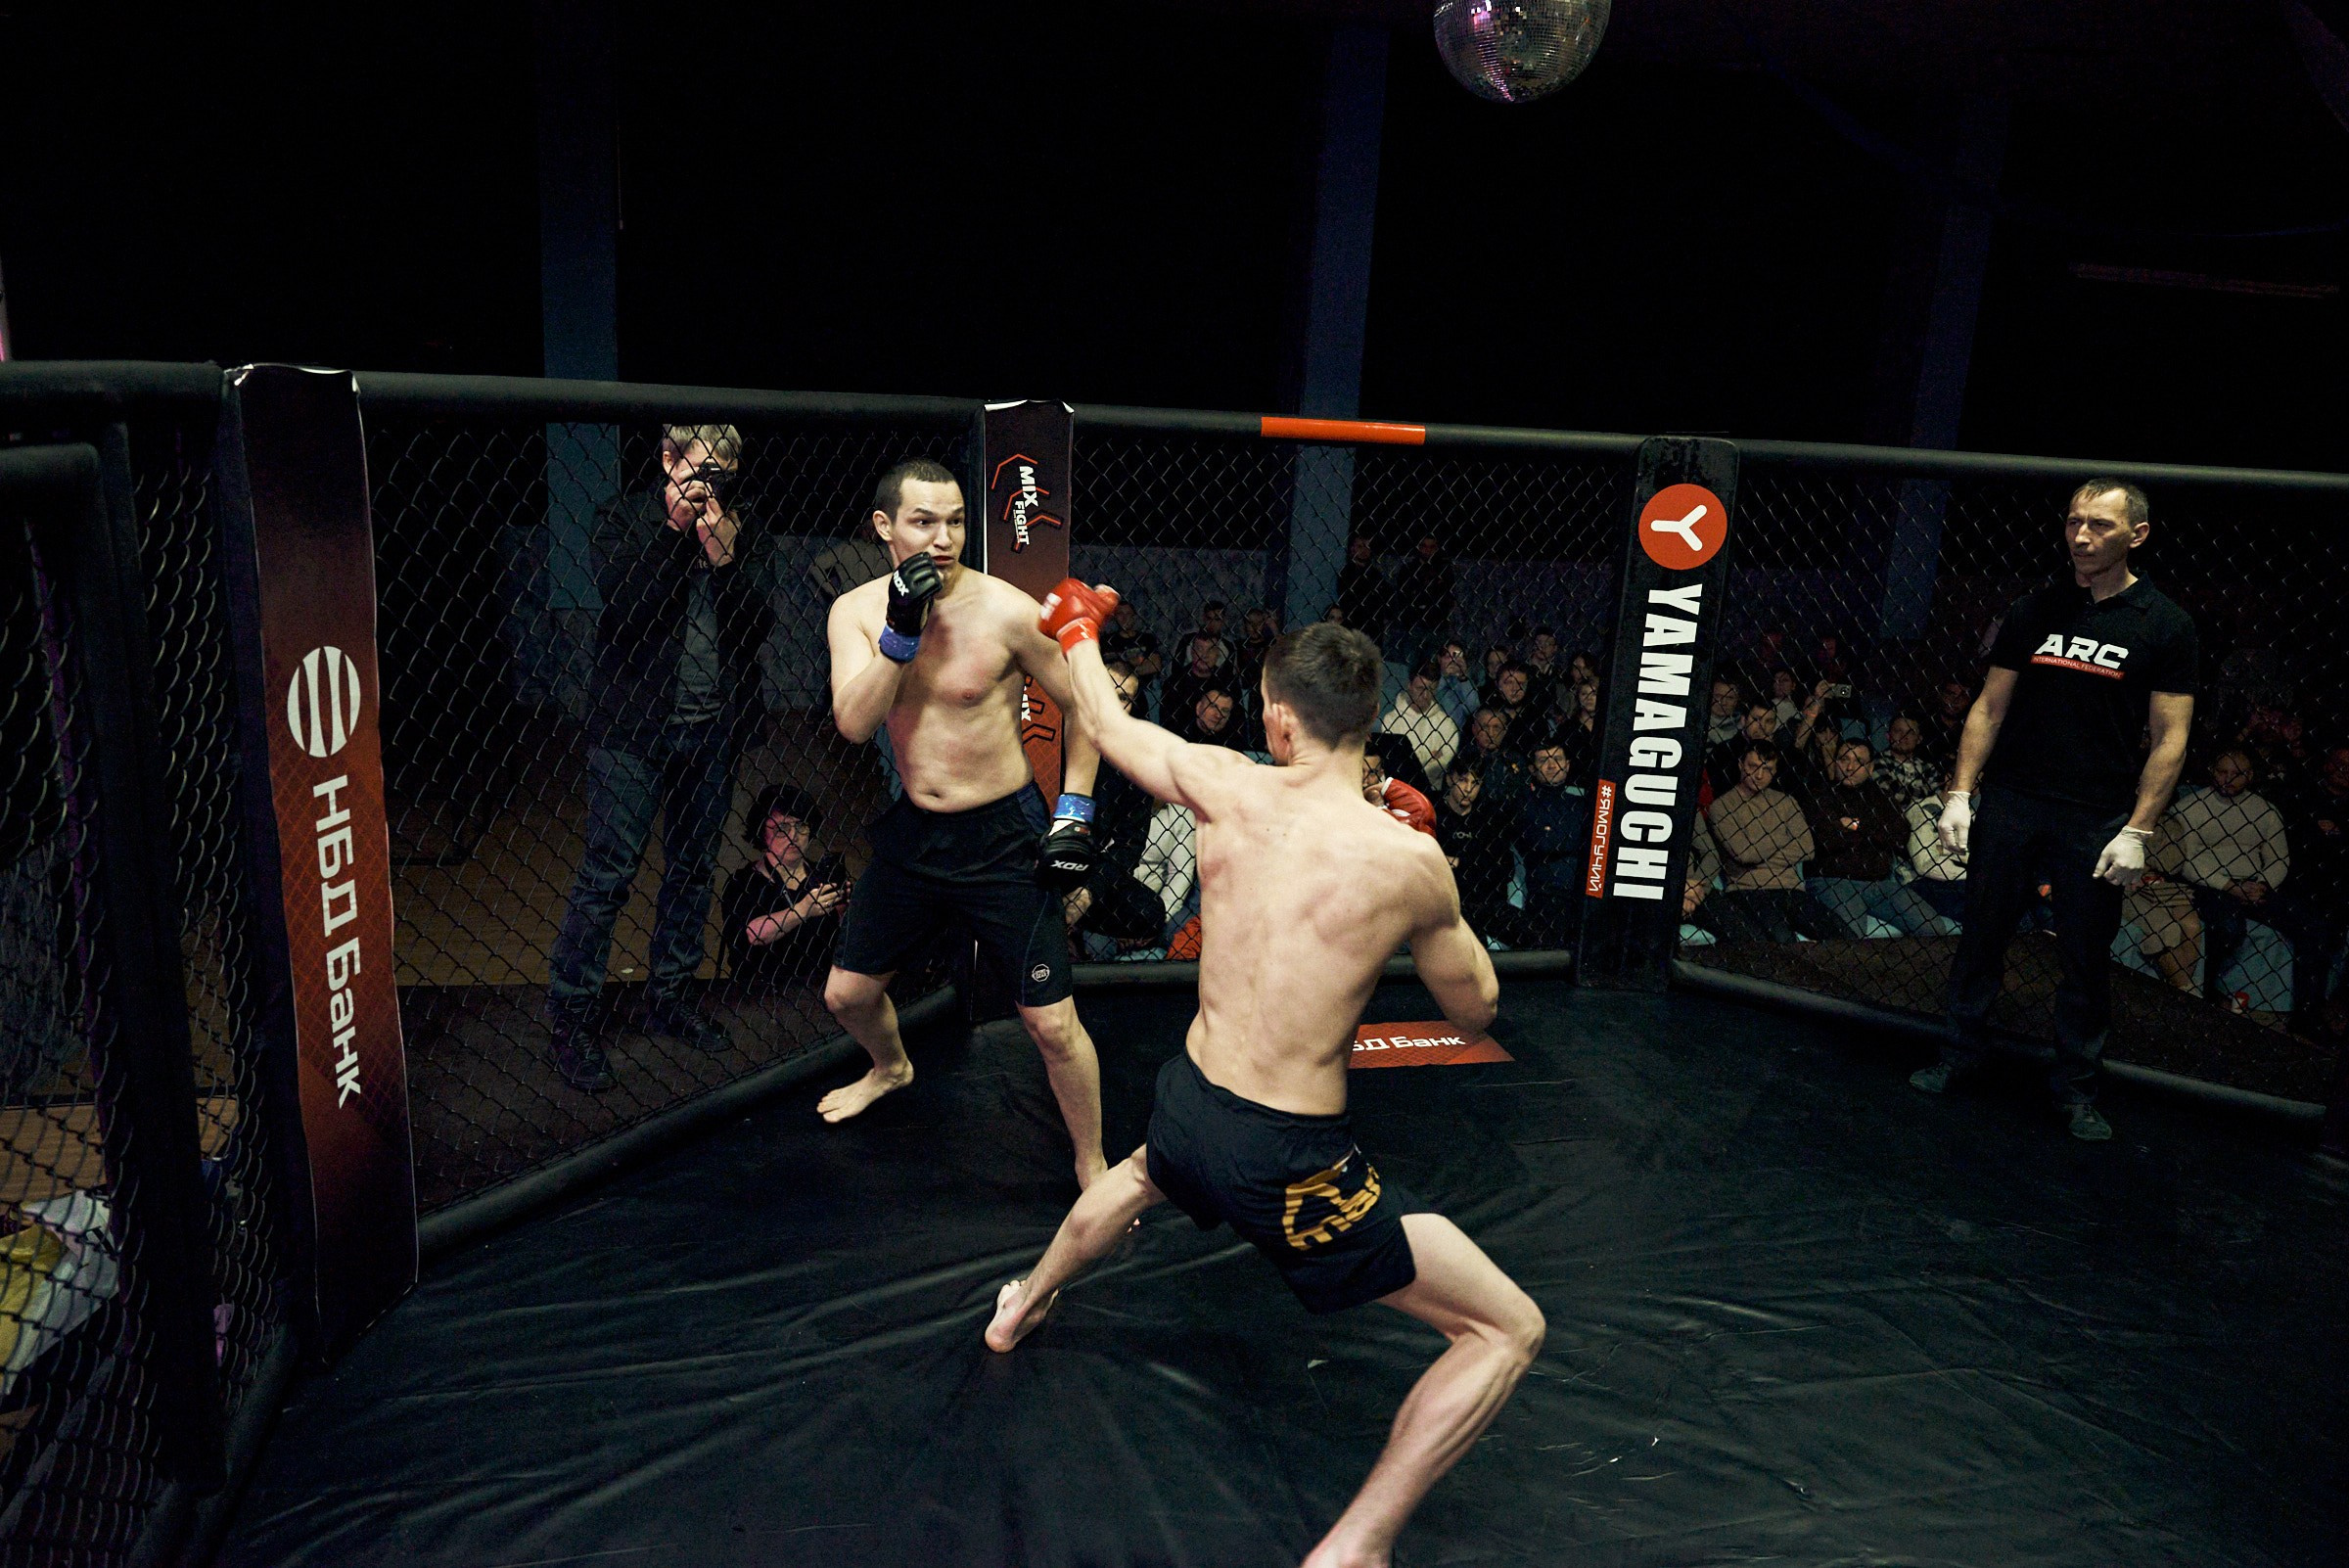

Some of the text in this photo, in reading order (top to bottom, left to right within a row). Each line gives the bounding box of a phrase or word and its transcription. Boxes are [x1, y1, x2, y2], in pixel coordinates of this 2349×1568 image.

[1019, 465, 1039, 508] MIX
[1014, 500, 1030, 545] FIGHT
[2032, 656, 2122, 678] INTERNATIONAL FEDERATION
[2034, 633, 2129, 669] ARC
[1612, 583, 1703, 900] YAMAGUCHI
[1050, 859, 1089, 871] RDX
[312, 774, 361, 1109] НБД Банк
[1389, 1036, 1466, 1049] Банк
